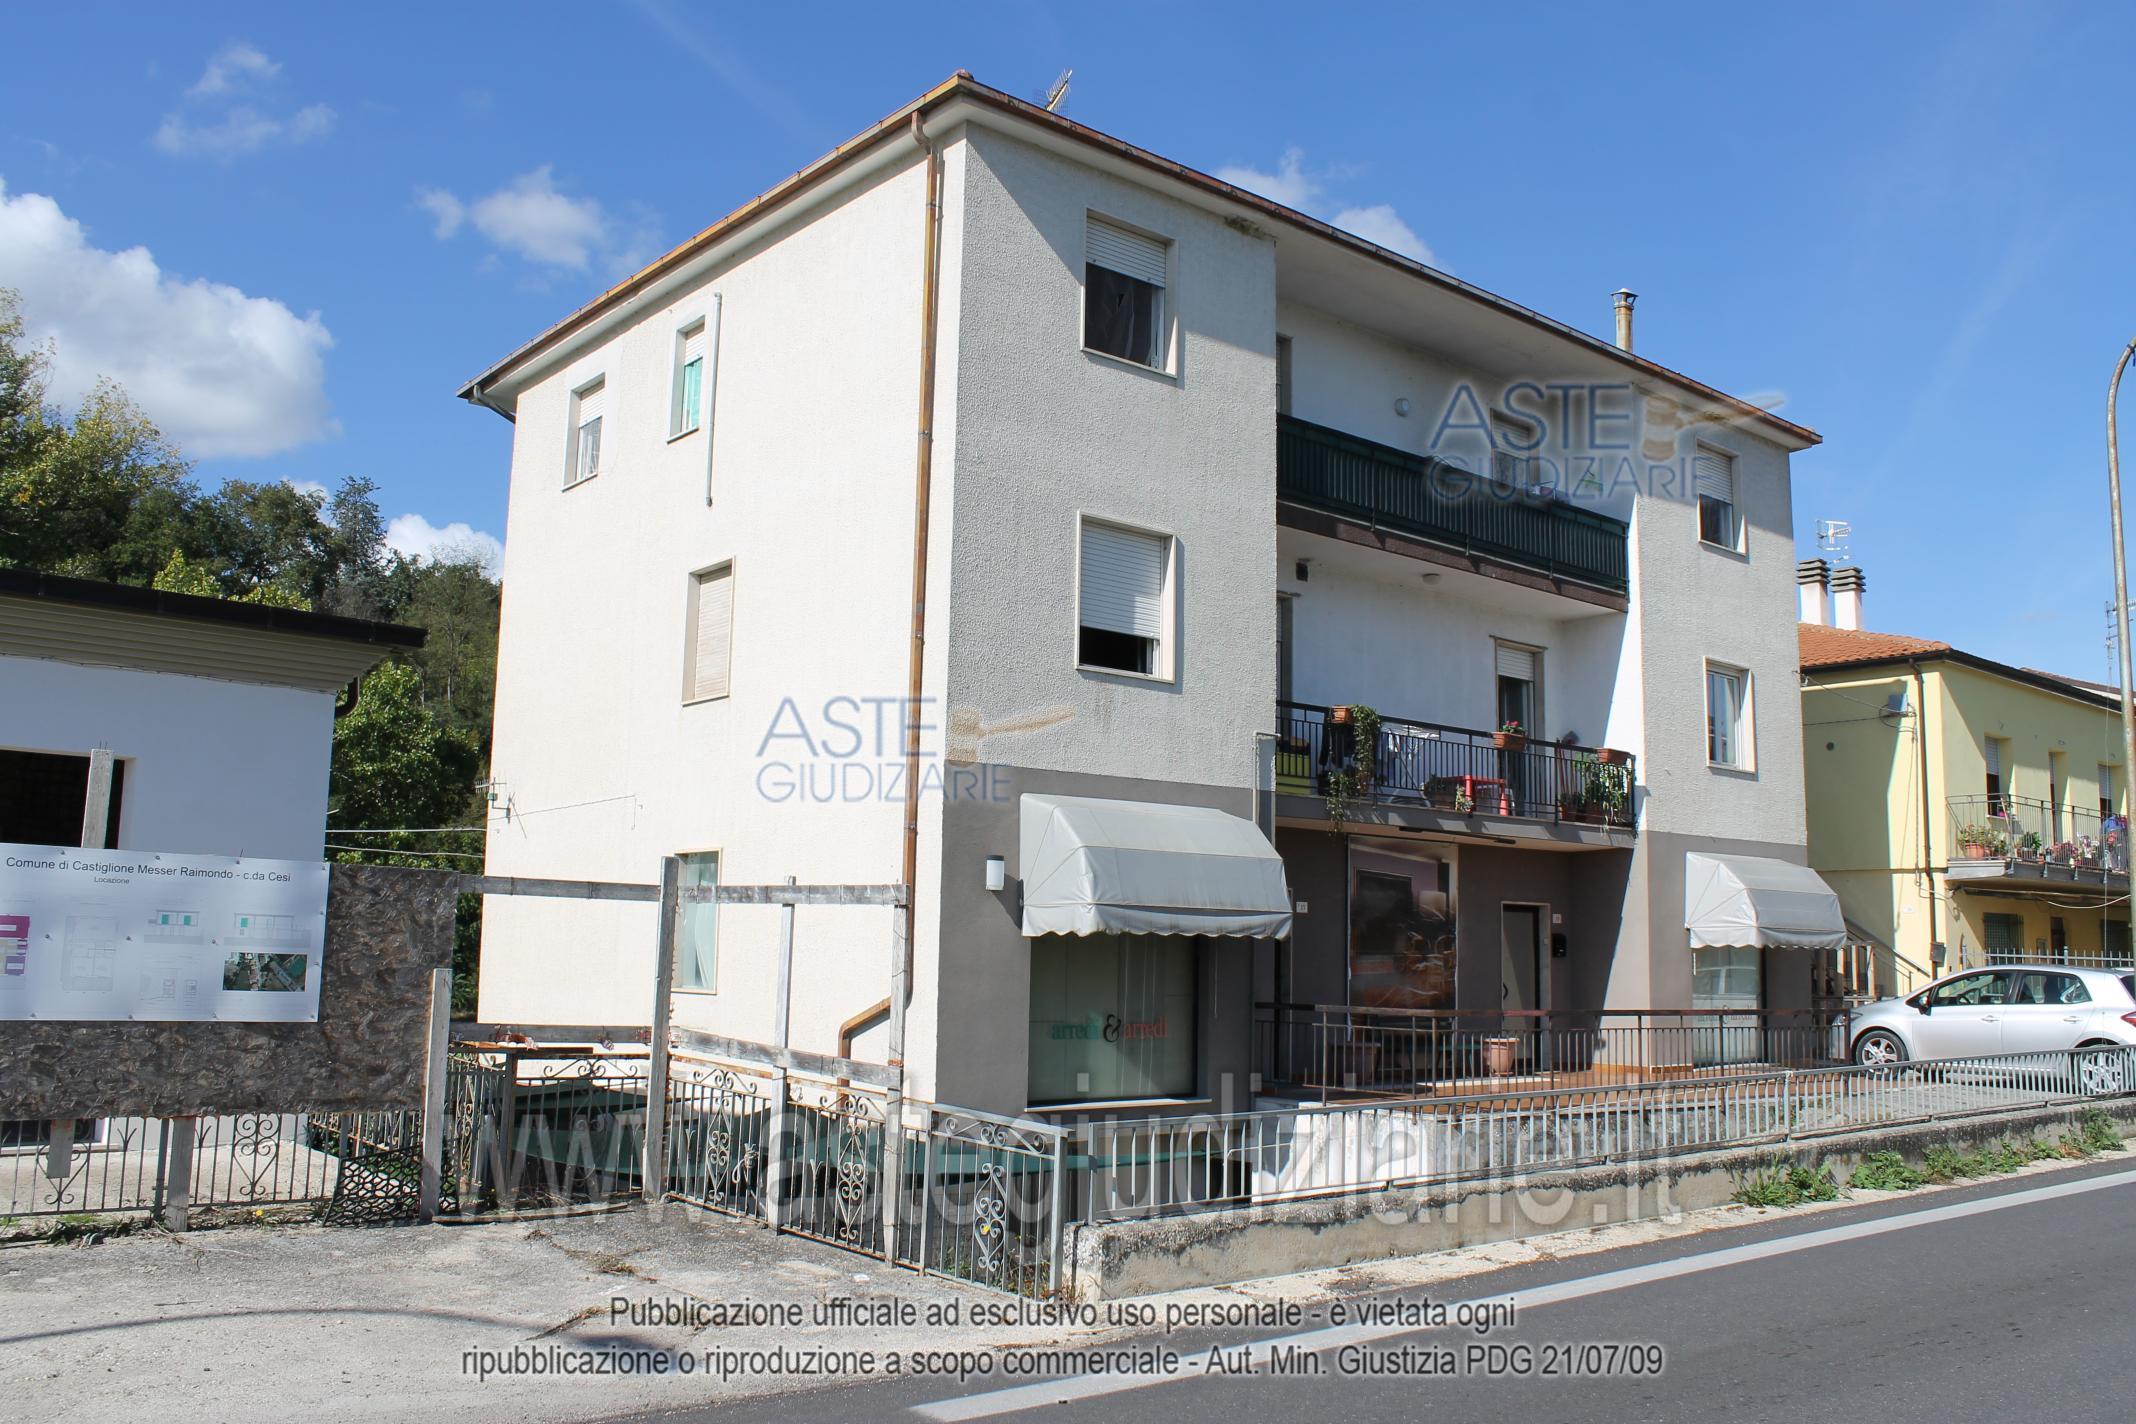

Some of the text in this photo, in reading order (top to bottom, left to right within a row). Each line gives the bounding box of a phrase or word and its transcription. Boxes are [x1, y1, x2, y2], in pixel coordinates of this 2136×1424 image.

[6, 857, 56, 870] Comune
[59, 859, 69, 870] di
[72, 860, 134, 875] Castiglione
[137, 864, 178, 876] Messer
[180, 866, 234, 879] Raimondo
[243, 872, 265, 881] c.da
[268, 871, 291, 882] Cesi
[94, 876, 130, 885] Locazione
[1103, 1013, 1122, 1043] &
